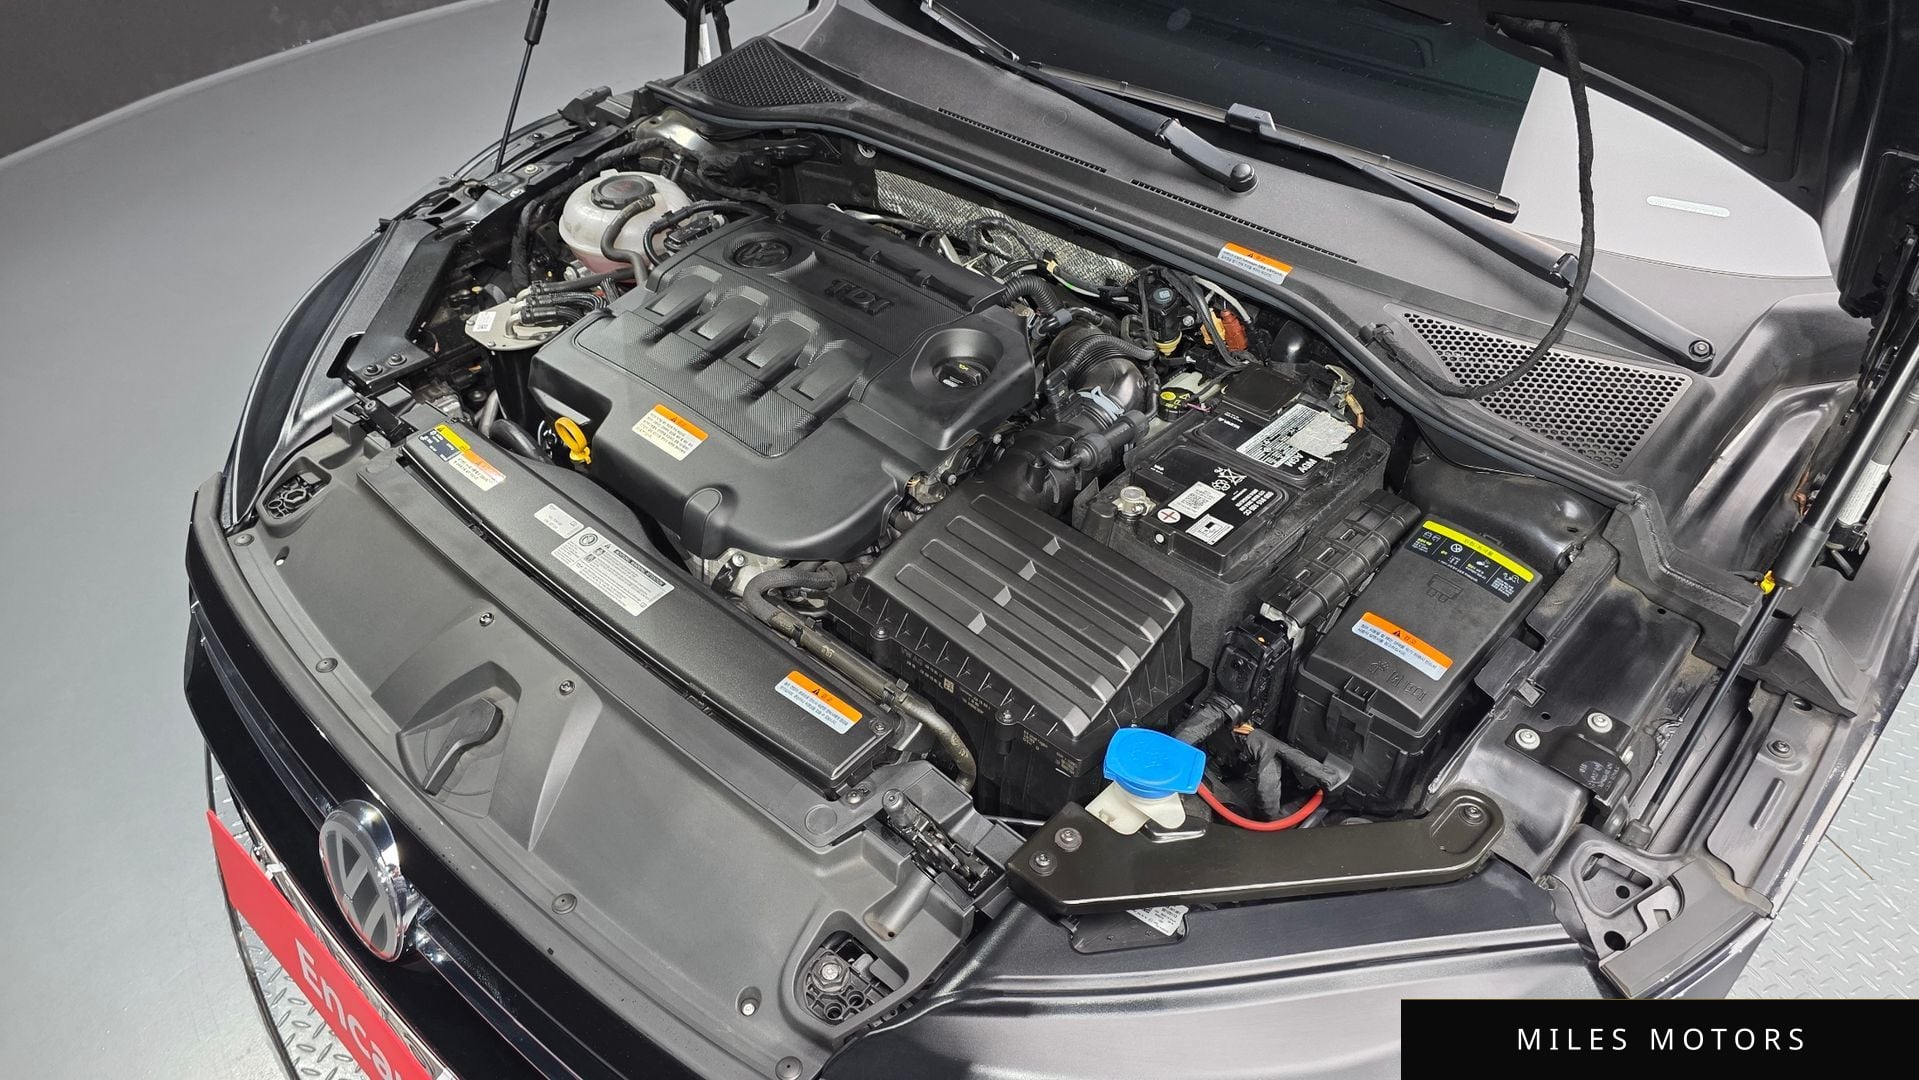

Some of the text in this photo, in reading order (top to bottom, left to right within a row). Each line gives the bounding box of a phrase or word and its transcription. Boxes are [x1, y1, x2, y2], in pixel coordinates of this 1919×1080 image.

[825, 279, 894, 316] TDI
[1297, 458, 1318, 474] AGM
[295, 936, 405, 1080] Enca
